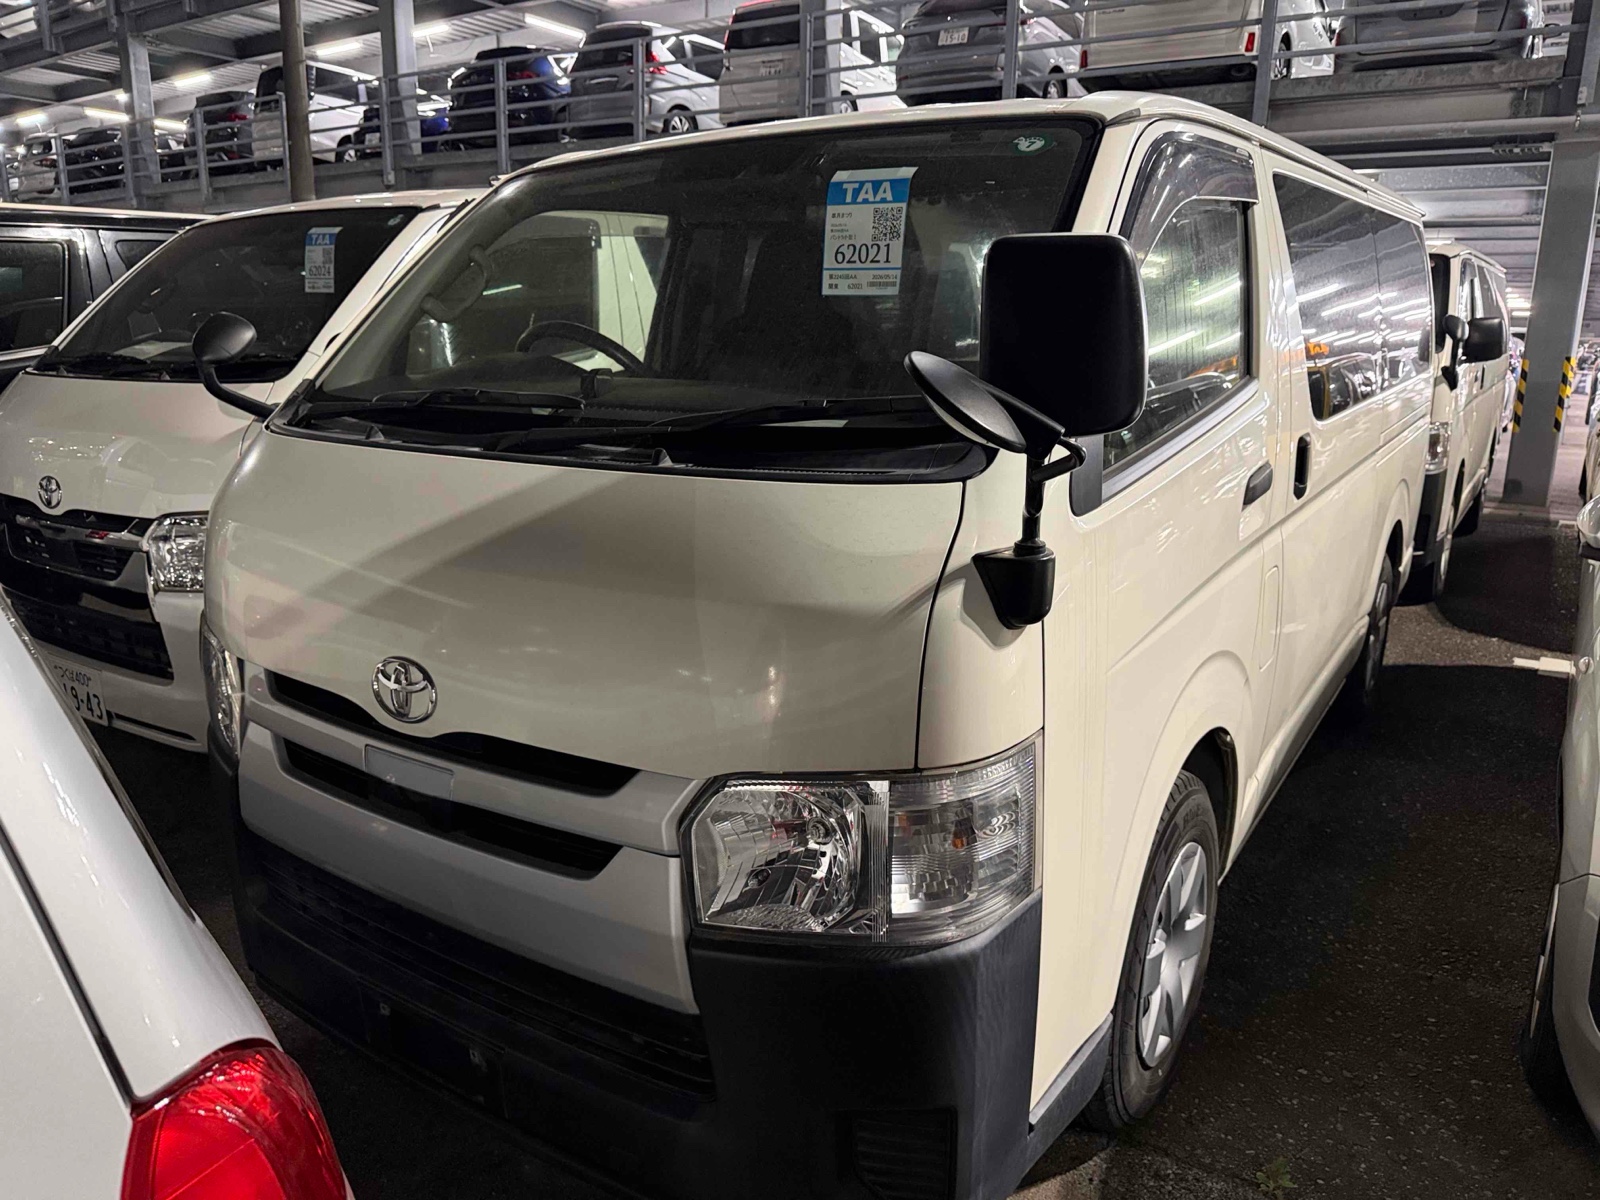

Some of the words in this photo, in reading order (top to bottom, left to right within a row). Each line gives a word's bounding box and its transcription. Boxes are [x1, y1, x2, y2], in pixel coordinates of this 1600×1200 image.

[1025, 140, 1037, 149] 7
[842, 181, 893, 203] TAA
[311, 234, 330, 245] TAA
[834, 243, 891, 265] 62021
[308, 265, 331, 277] 62024
